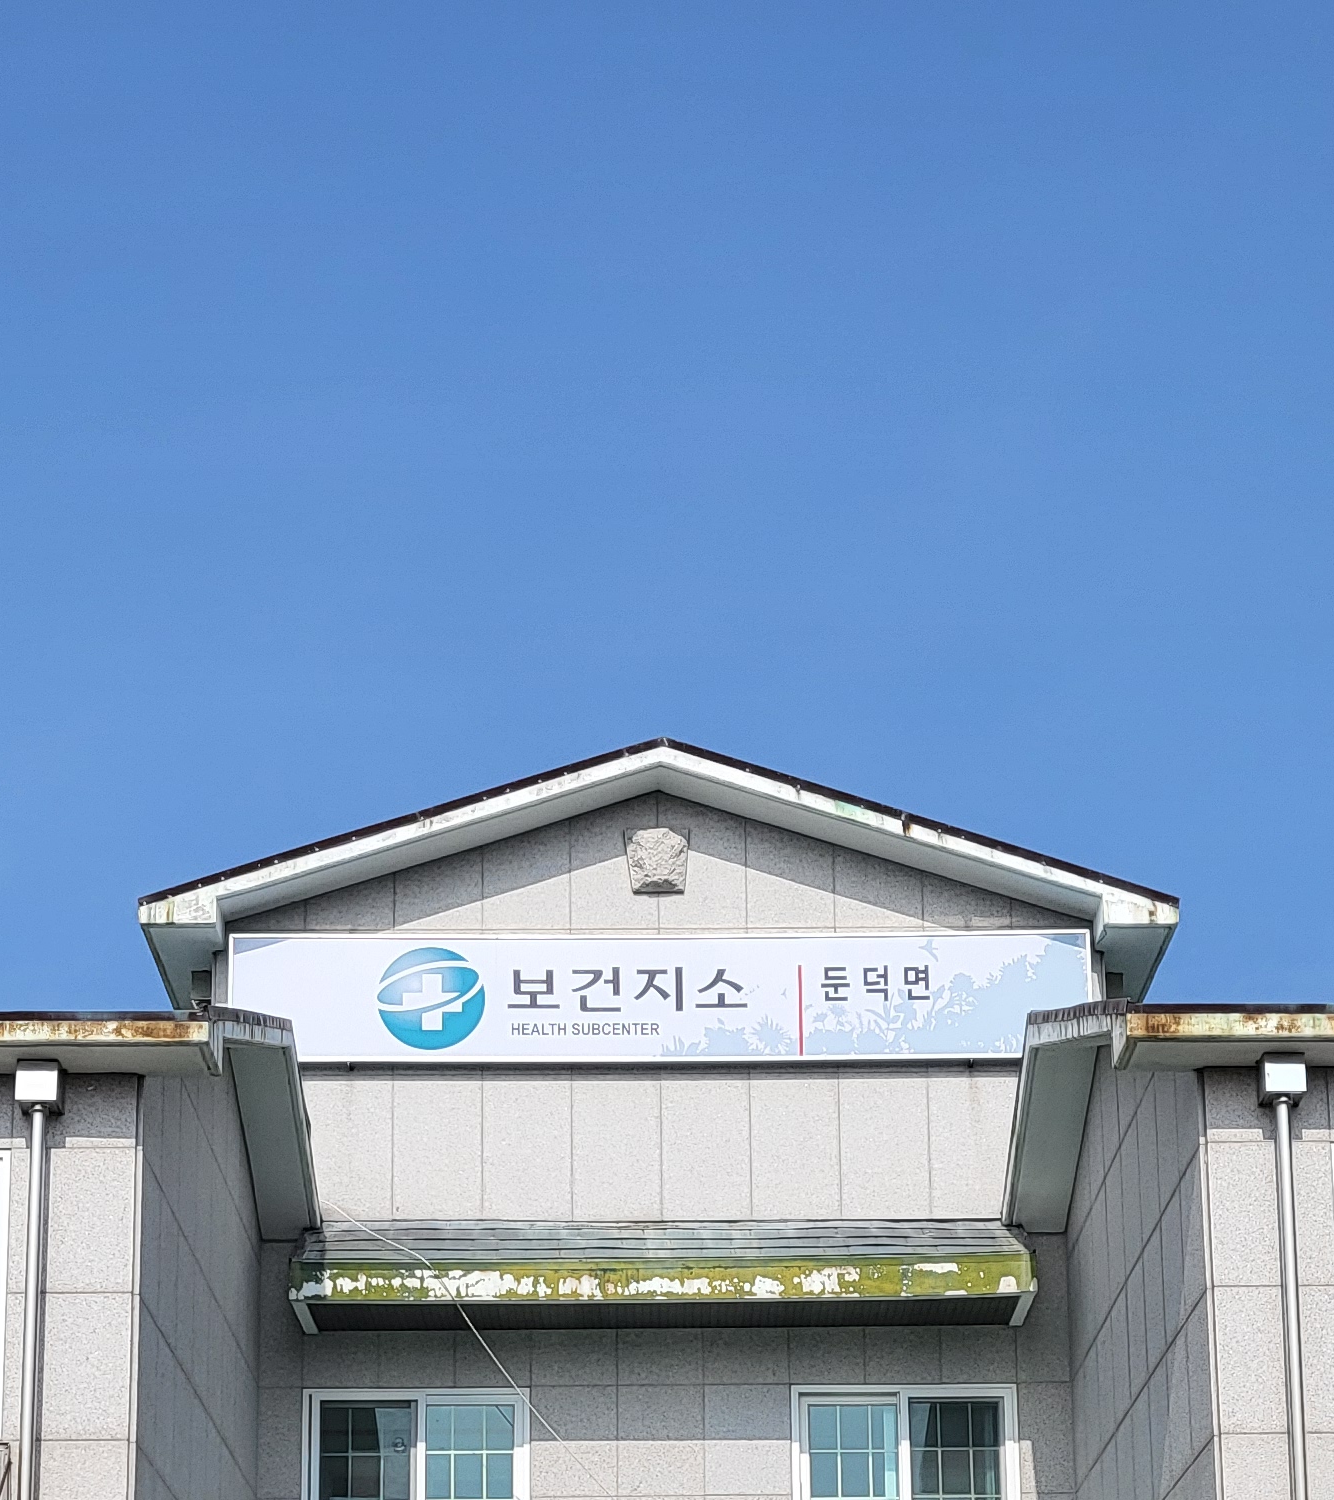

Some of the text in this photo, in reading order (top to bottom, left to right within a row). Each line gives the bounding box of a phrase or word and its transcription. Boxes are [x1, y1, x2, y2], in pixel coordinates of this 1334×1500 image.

[507, 966, 748, 1012] 보건지소
[820, 964, 931, 1002] 둔덕면
[511, 1022, 661, 1036] HEALTH SUBCENTER
